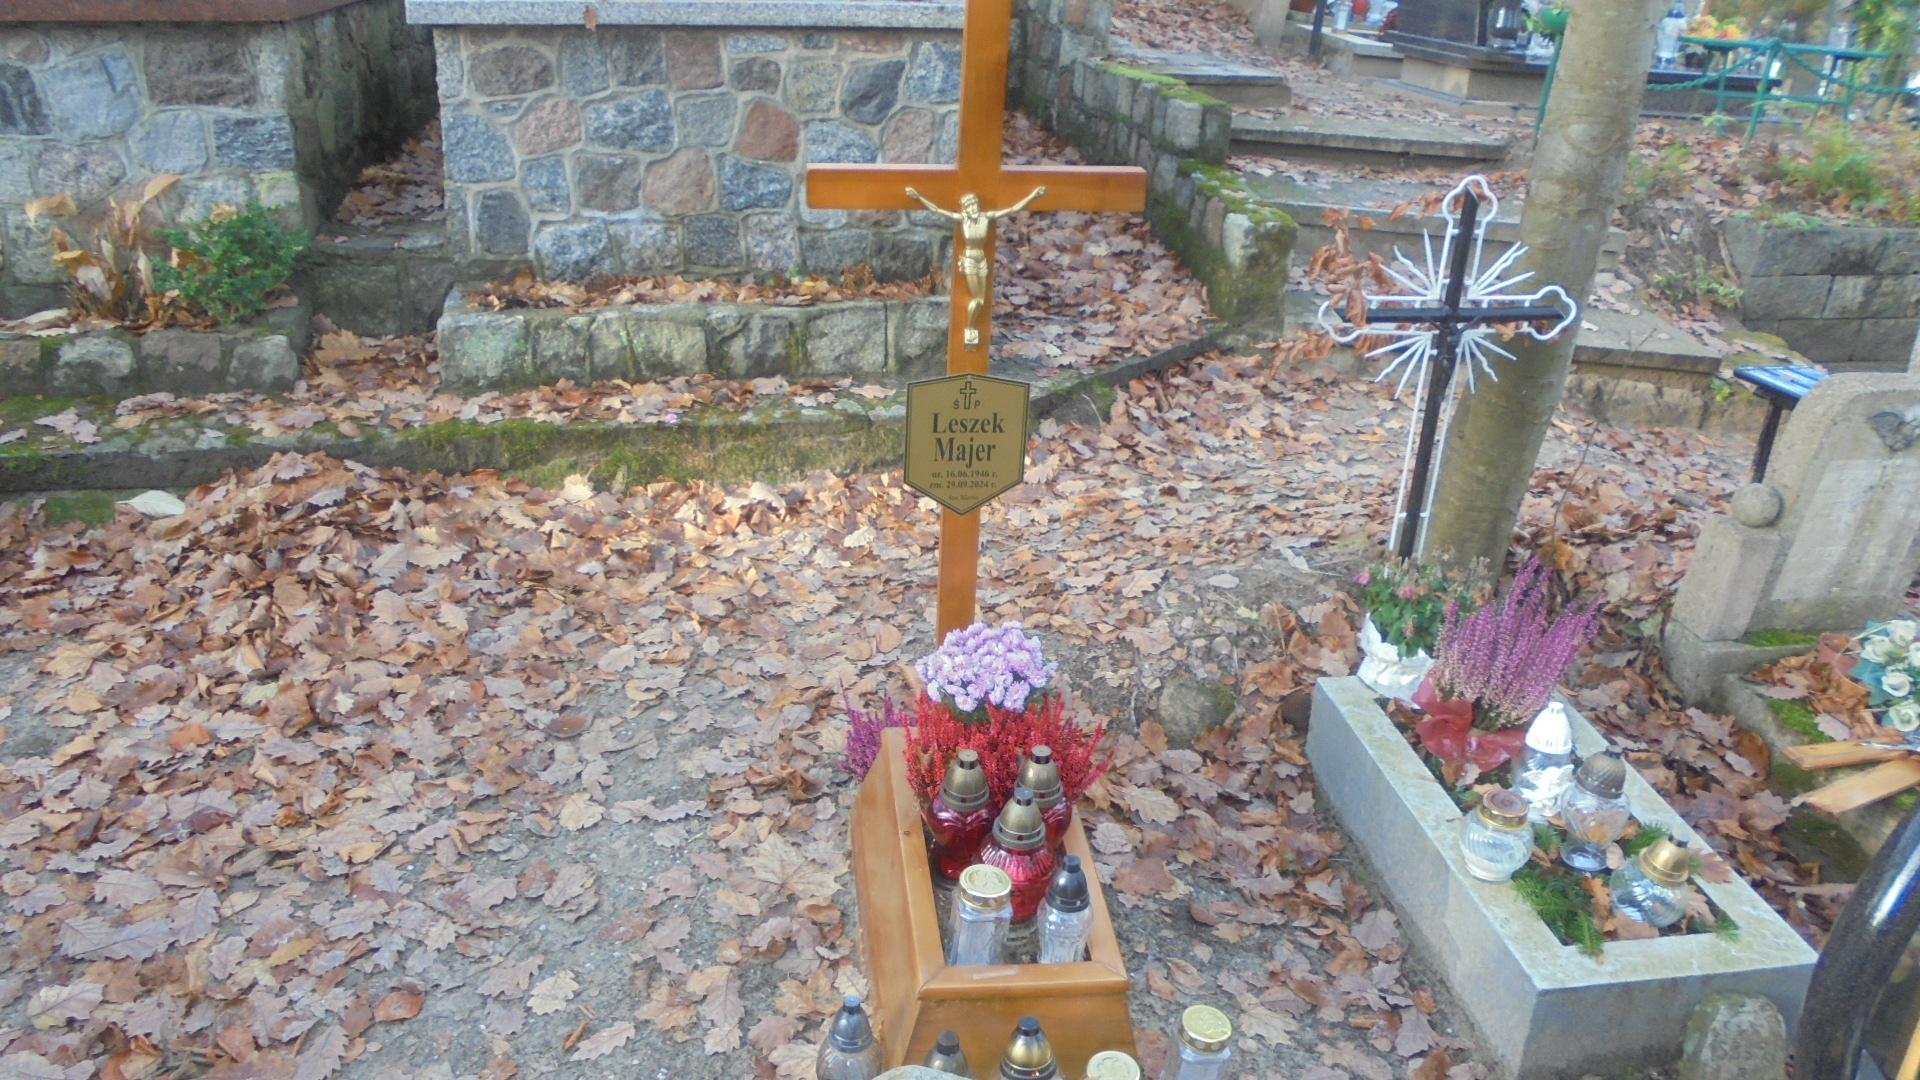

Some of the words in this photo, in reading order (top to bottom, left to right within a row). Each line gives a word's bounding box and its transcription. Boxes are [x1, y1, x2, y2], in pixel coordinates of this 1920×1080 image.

[974, 400, 981, 410] P
[932, 412, 1005, 434] Leszek
[934, 437, 997, 469] Majer
[946, 470, 990, 479] 16.06.1946
[946, 480, 989, 489] 29.09.2024
